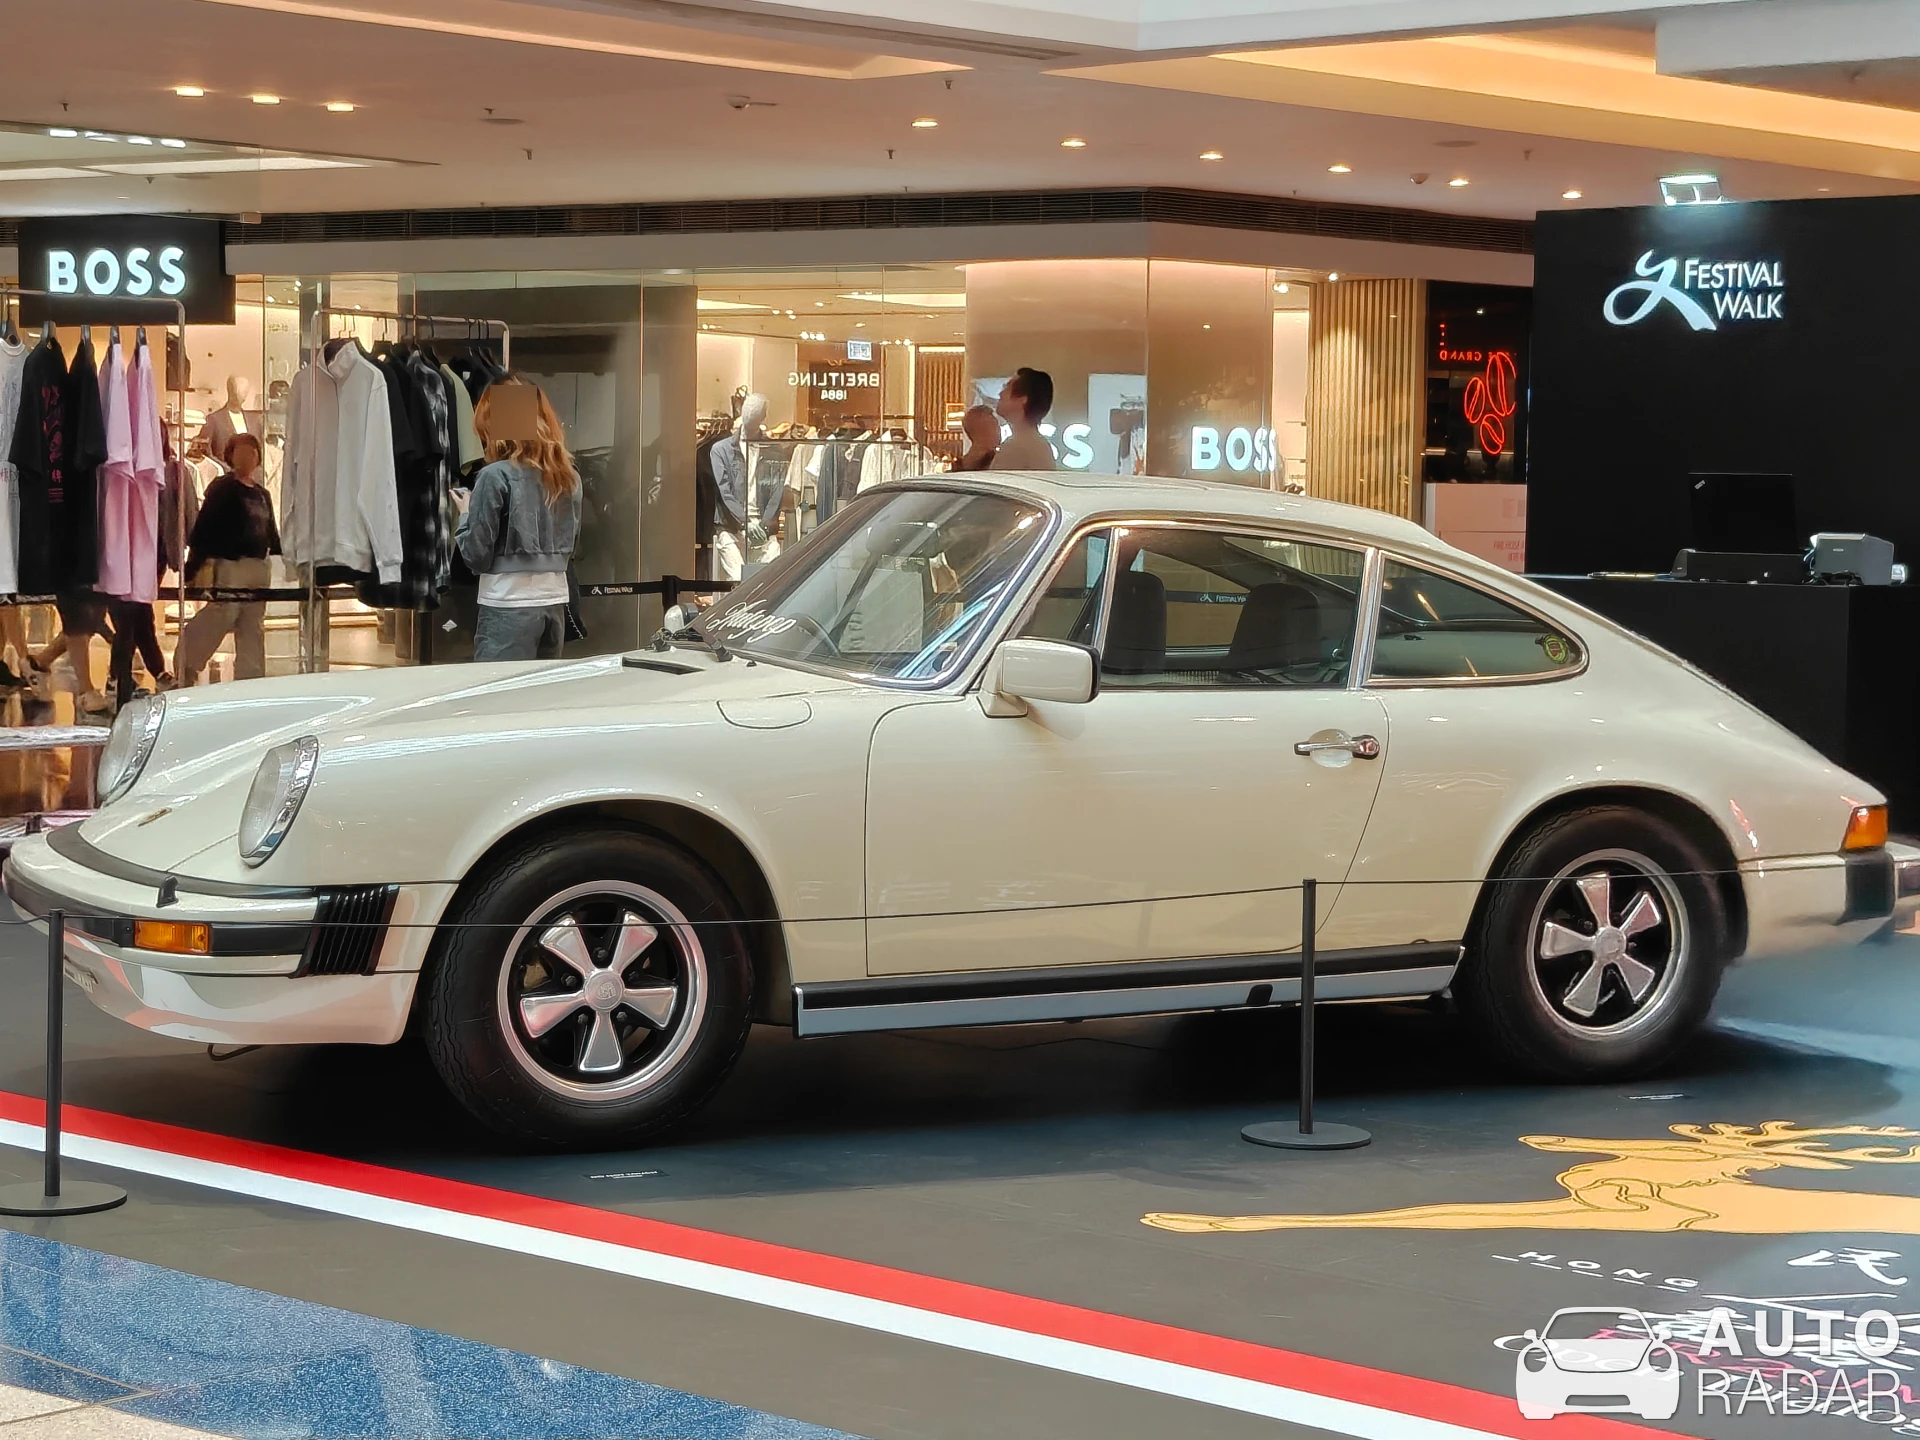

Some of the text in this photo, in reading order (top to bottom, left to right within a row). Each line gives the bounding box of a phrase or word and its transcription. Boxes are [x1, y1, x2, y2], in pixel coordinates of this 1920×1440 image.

[48, 247, 186, 296] BOSS
[1684, 259, 1784, 289] FESTIVAL
[1713, 291, 1783, 320] WALK
[1191, 425, 1277, 472] BOSS
[1518, 1250, 1700, 1288] HONG
